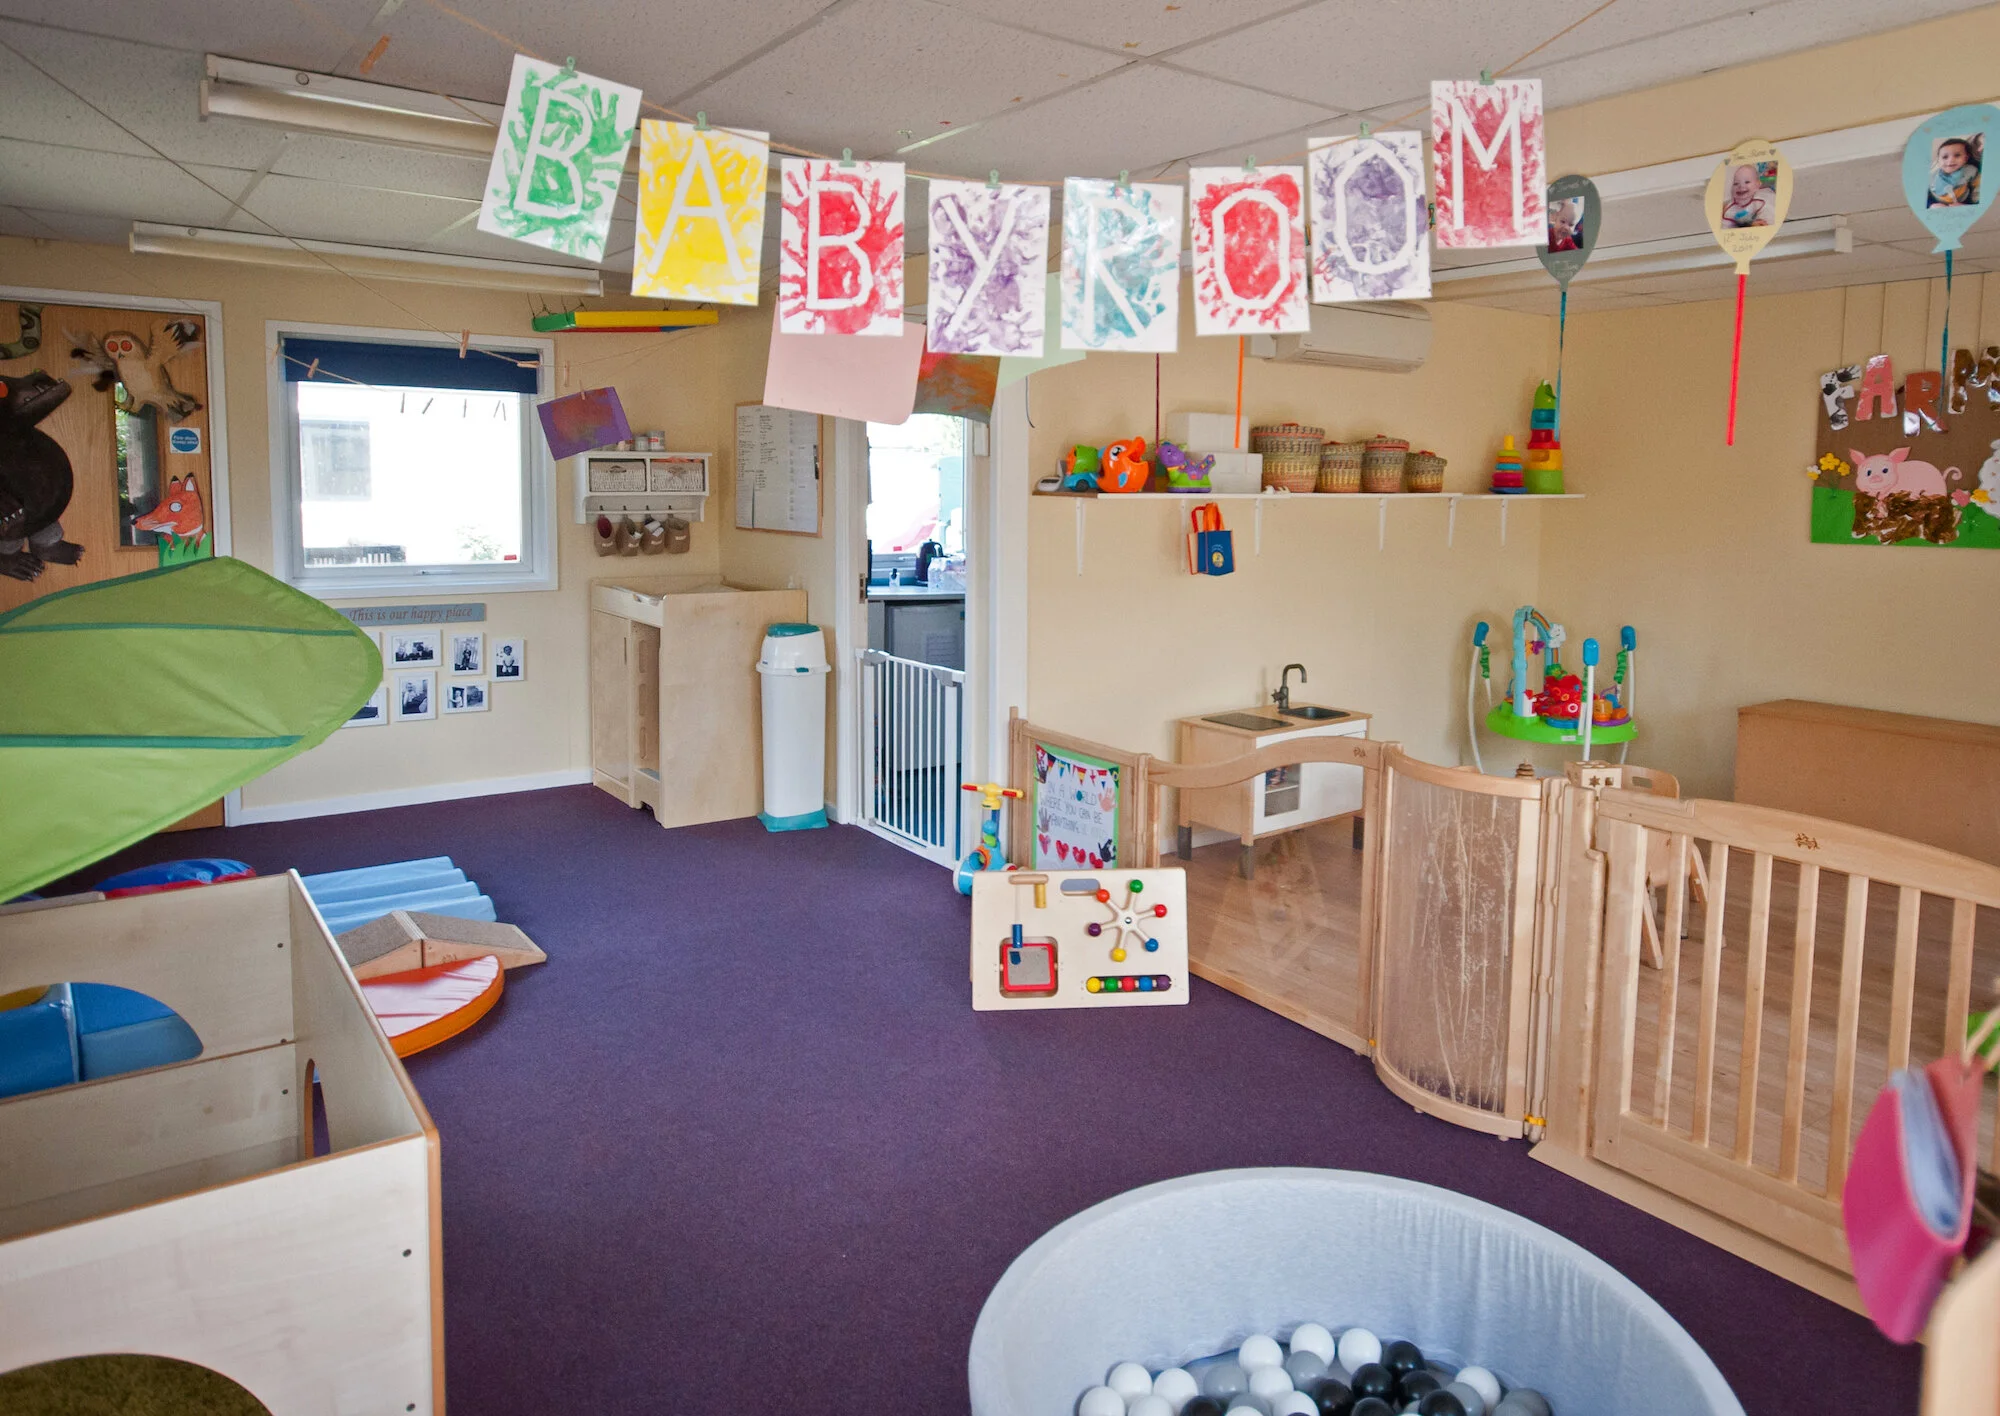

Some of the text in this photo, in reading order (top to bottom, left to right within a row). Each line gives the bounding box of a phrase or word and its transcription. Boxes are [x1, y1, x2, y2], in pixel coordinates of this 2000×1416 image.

[1820, 346, 2000, 438] FARM
[349, 605, 473, 623] This is our happy place
